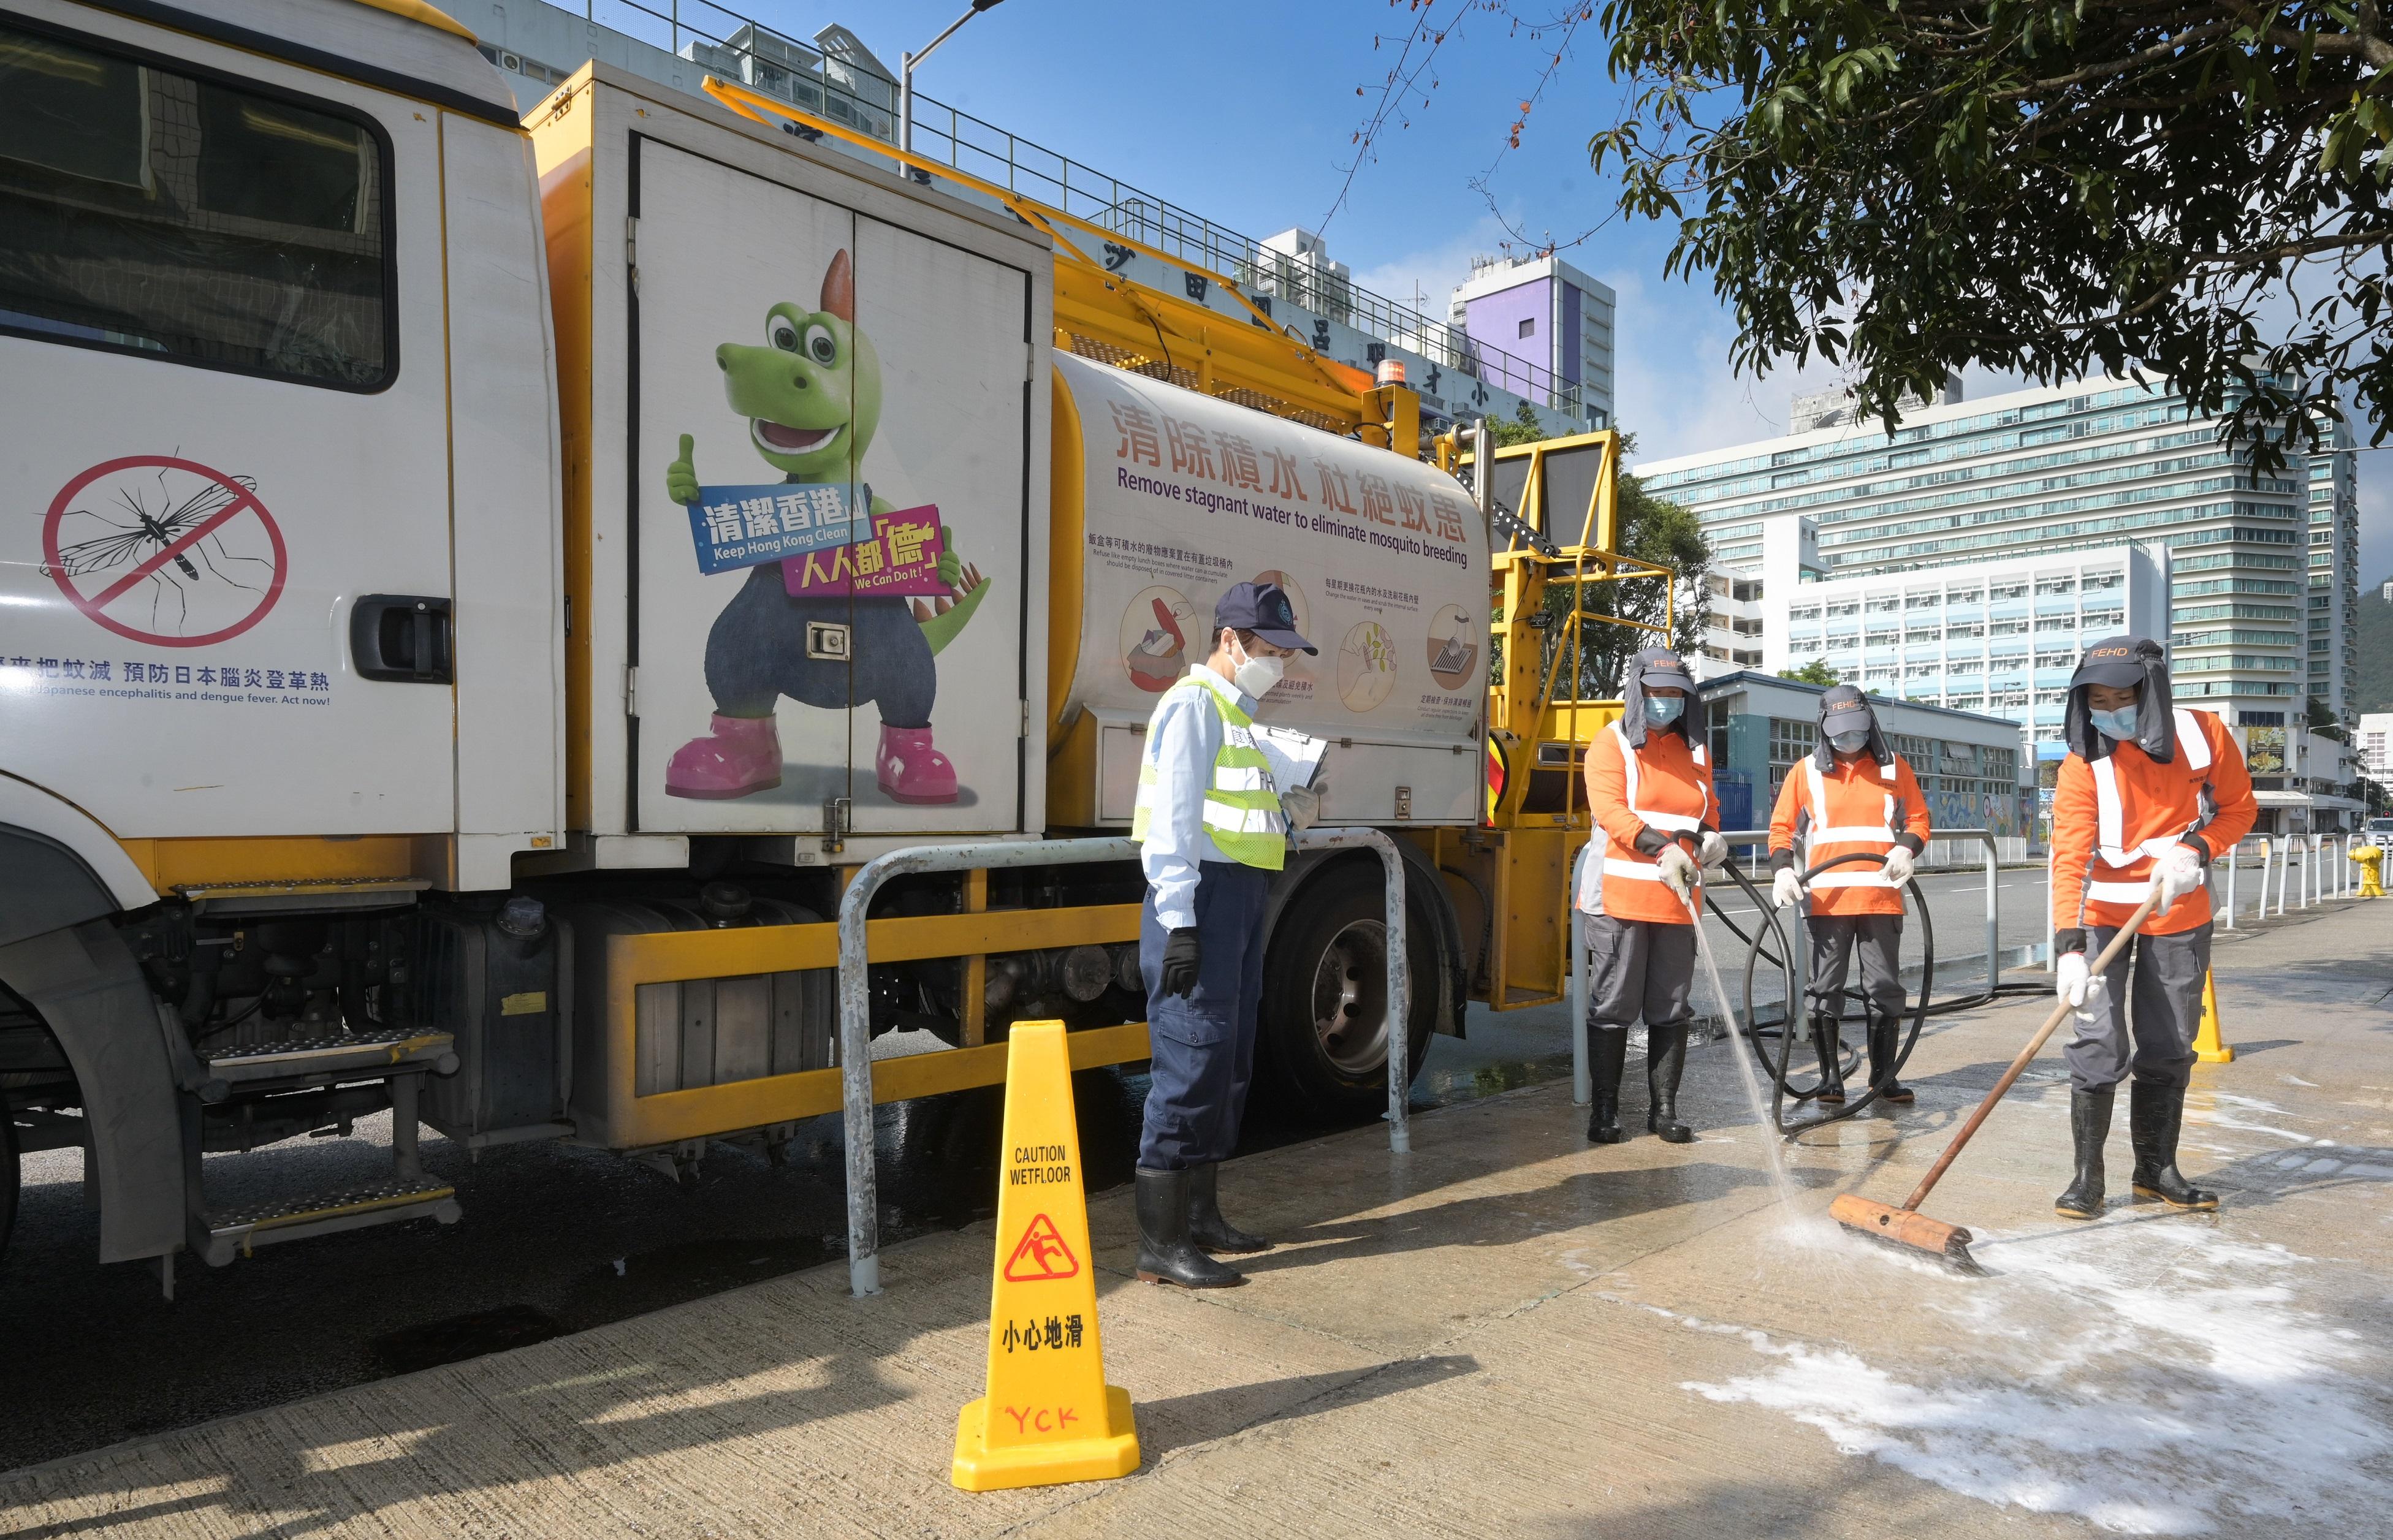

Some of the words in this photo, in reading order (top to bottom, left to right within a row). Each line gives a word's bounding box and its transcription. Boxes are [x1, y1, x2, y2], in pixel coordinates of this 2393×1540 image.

[1106, 398, 1308, 502] 清除積水
[1313, 458, 1467, 544] 杜絕蚊患
[703, 487, 852, 545] 清潔香港
[1117, 466, 1181, 500] Remove
[1185, 486, 1249, 513] stagnant
[1252, 503, 1291, 525] water
[1294, 510, 1308, 529] to
[1311, 514, 1367, 543] eliminate
[1369, 530, 1420, 555] mosquito
[1423, 539, 1467, 570] breeding
[713, 545, 746, 561] Keep
[747, 540, 781, 554] Hong
[782, 534, 813, 548] Kong
[815, 528, 848, 542] Clean
[1093, 548, 1110, 558] Refuse
[1121, 554, 1136, 563] empty
[1138, 556, 1151, 564] lunch
[1152, 558, 1165, 567] boxes
[1203, 569, 1228, 578] accumulate
[1106, 559, 1123, 568] should
[1132, 564, 1152, 573] disposed
[1165, 569, 1182, 578] covered
[1195, 575, 1218, 584] containers
[854, 578, 871, 590] We
[872, 574, 892, 586] Can
[894, 571, 908, 582] Do
[1325, 590, 1339, 599] Change
[2091, 647, 2128, 659] FEHD
[123, 661, 330, 692] 預防日本腦炎登革熱
[38, 685, 96, 697] Japanese
[99, 688, 172, 700] encephalitis
[175, 691, 197, 700] and
[200, 691, 244, 704] dengue
[246, 693, 278, 704] fever.
[281, 695, 299, 705] Act
[1832, 700, 1855, 711] FEHD
[1015, 1145, 1065, 1164] CAUTION
[1010, 1166, 1071, 1186] WETFLOOR
[1002, 1314, 1083, 1354] 小心地滑
[1005, 1405, 1079, 1435] YCK
